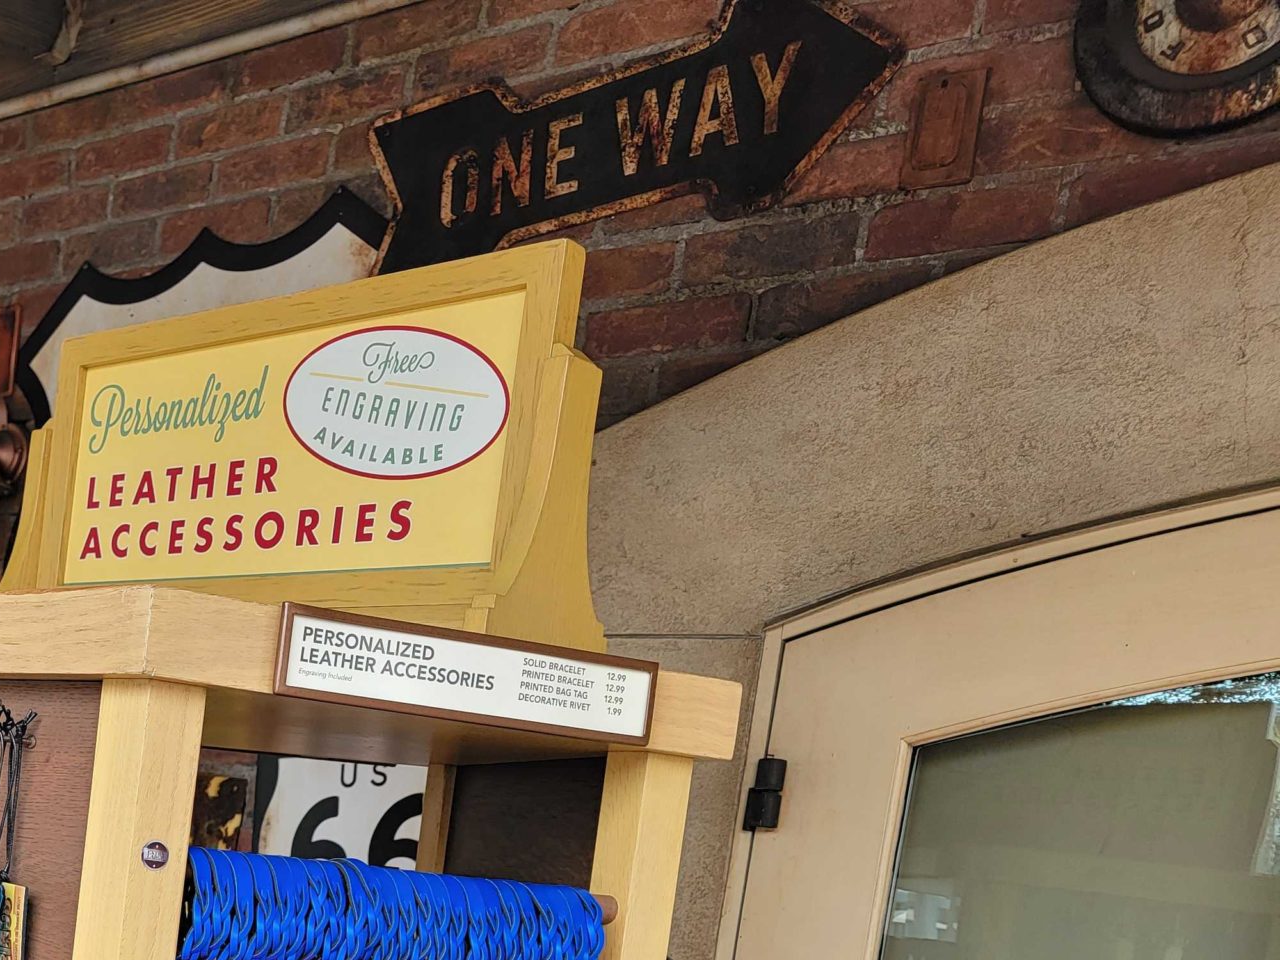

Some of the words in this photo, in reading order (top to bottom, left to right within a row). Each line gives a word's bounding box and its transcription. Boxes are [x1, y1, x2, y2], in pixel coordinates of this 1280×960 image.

[439, 112, 584, 229] ONE
[616, 40, 803, 176] WAY
[362, 341, 436, 384] Free
[89, 365, 270, 455] Personalized
[321, 386, 465, 433] ENGRAVING
[313, 426, 445, 466] AVAILABLE
[86, 456, 280, 510] LEATHER
[79, 500, 413, 560] ACCESSORIES
[303, 626, 434, 661] PERSONALIZED
[298, 668, 327, 679] Engraving
[328, 671, 352, 682] Included
[300, 646, 376, 673] LEATHER
[381, 660, 495, 690] ACCESSORIES
[521, 669, 555, 682] PRINTED
[557, 675, 595, 689] BRACELET
[606, 684, 625, 693] 12.99
[523, 658, 546, 669] SOLID
[549, 662, 586, 676] BRACELET
[607, 673, 626, 682] 12.99
[518, 693, 567, 708] DECORATIVE
[569, 701, 591, 712] RIVET
[607, 707, 622, 716] 1.99
[520, 681, 553, 693] PRINTED
[555, 686, 571, 697] BAG
[573, 690, 588, 700] TAG
[604, 695, 623, 705] 12.99
